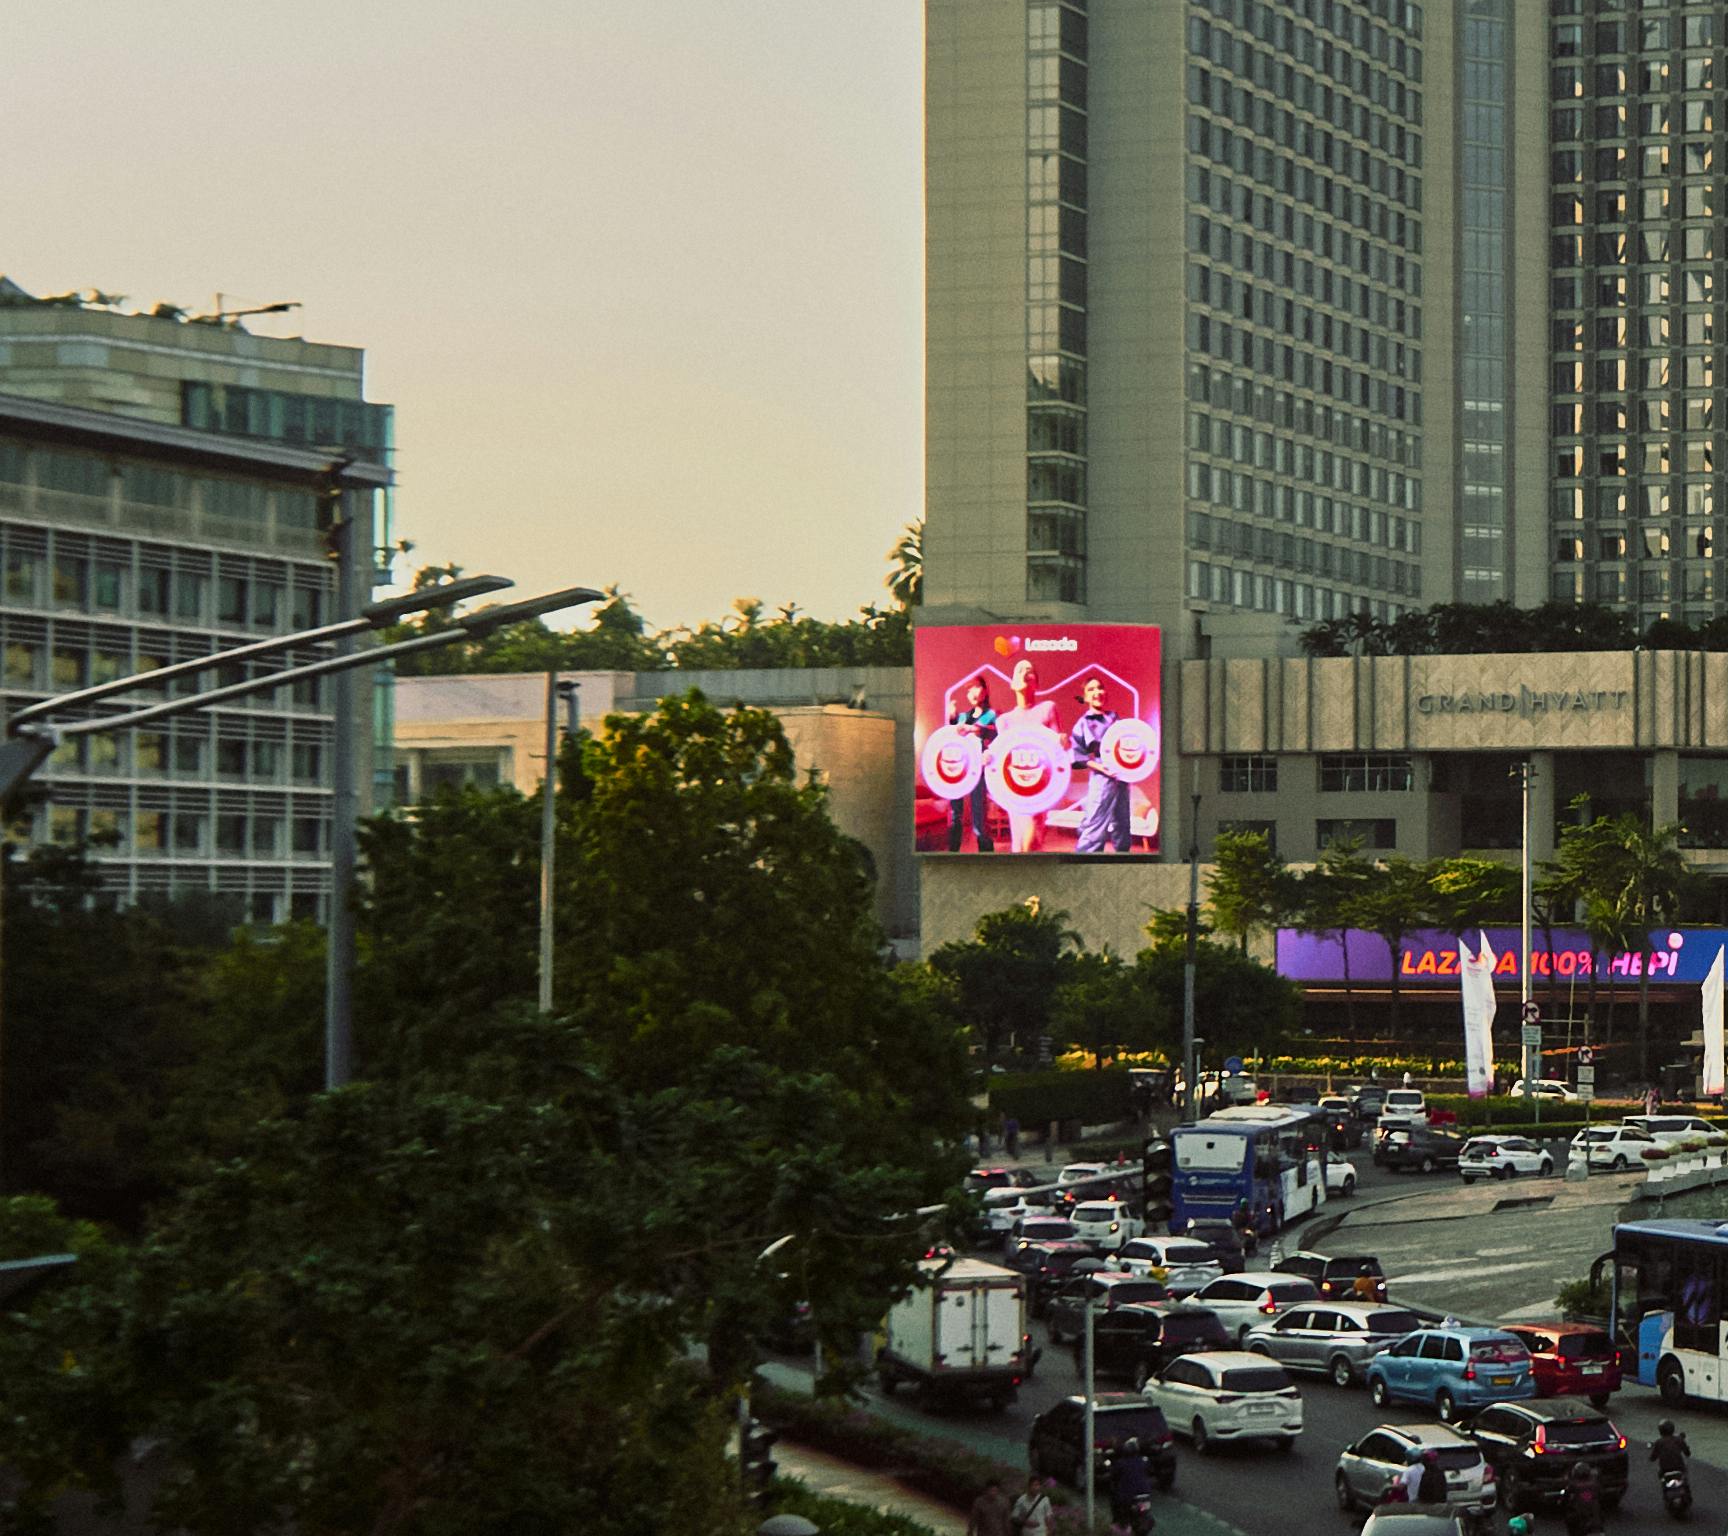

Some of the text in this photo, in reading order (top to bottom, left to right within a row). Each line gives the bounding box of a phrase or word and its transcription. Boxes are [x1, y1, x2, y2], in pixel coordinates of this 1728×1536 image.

[1024, 635, 1078, 652] Lazada
[1416, 690, 1627, 714] GRAND HYATT
